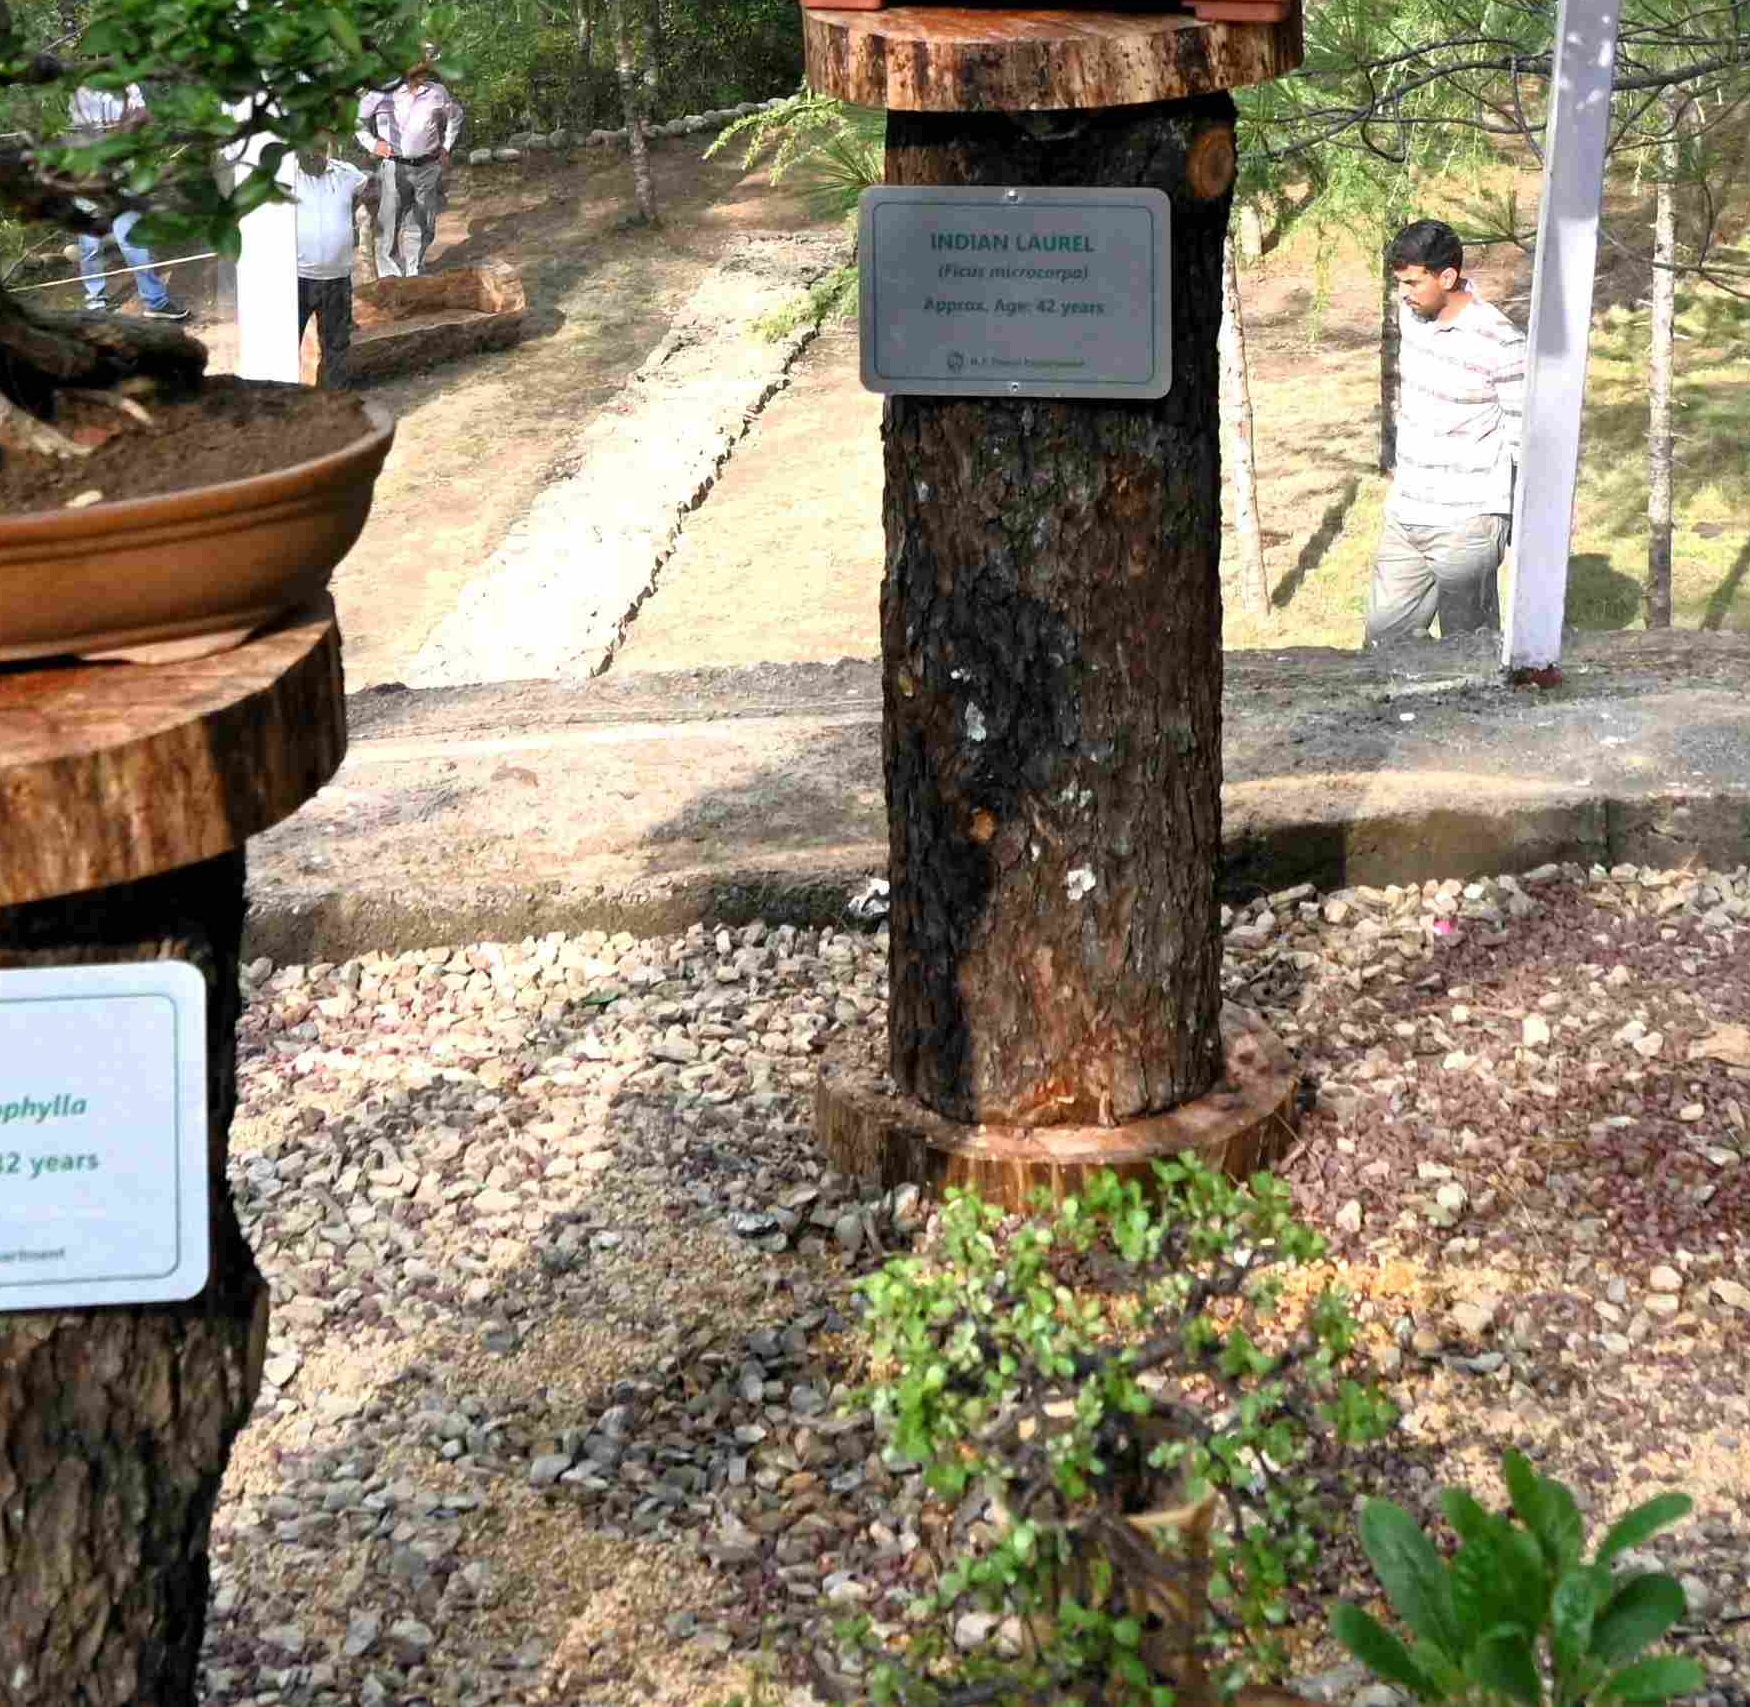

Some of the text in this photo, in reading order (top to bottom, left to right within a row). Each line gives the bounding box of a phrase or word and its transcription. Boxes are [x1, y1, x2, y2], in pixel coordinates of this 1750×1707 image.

[931, 232, 1096, 254] INDIAN LAUREL
[938, 263, 986, 280] (Ficus
[1035, 299, 1057, 315] 42
[1062, 301, 1105, 317] years
[30, 1151, 100, 1180] years
